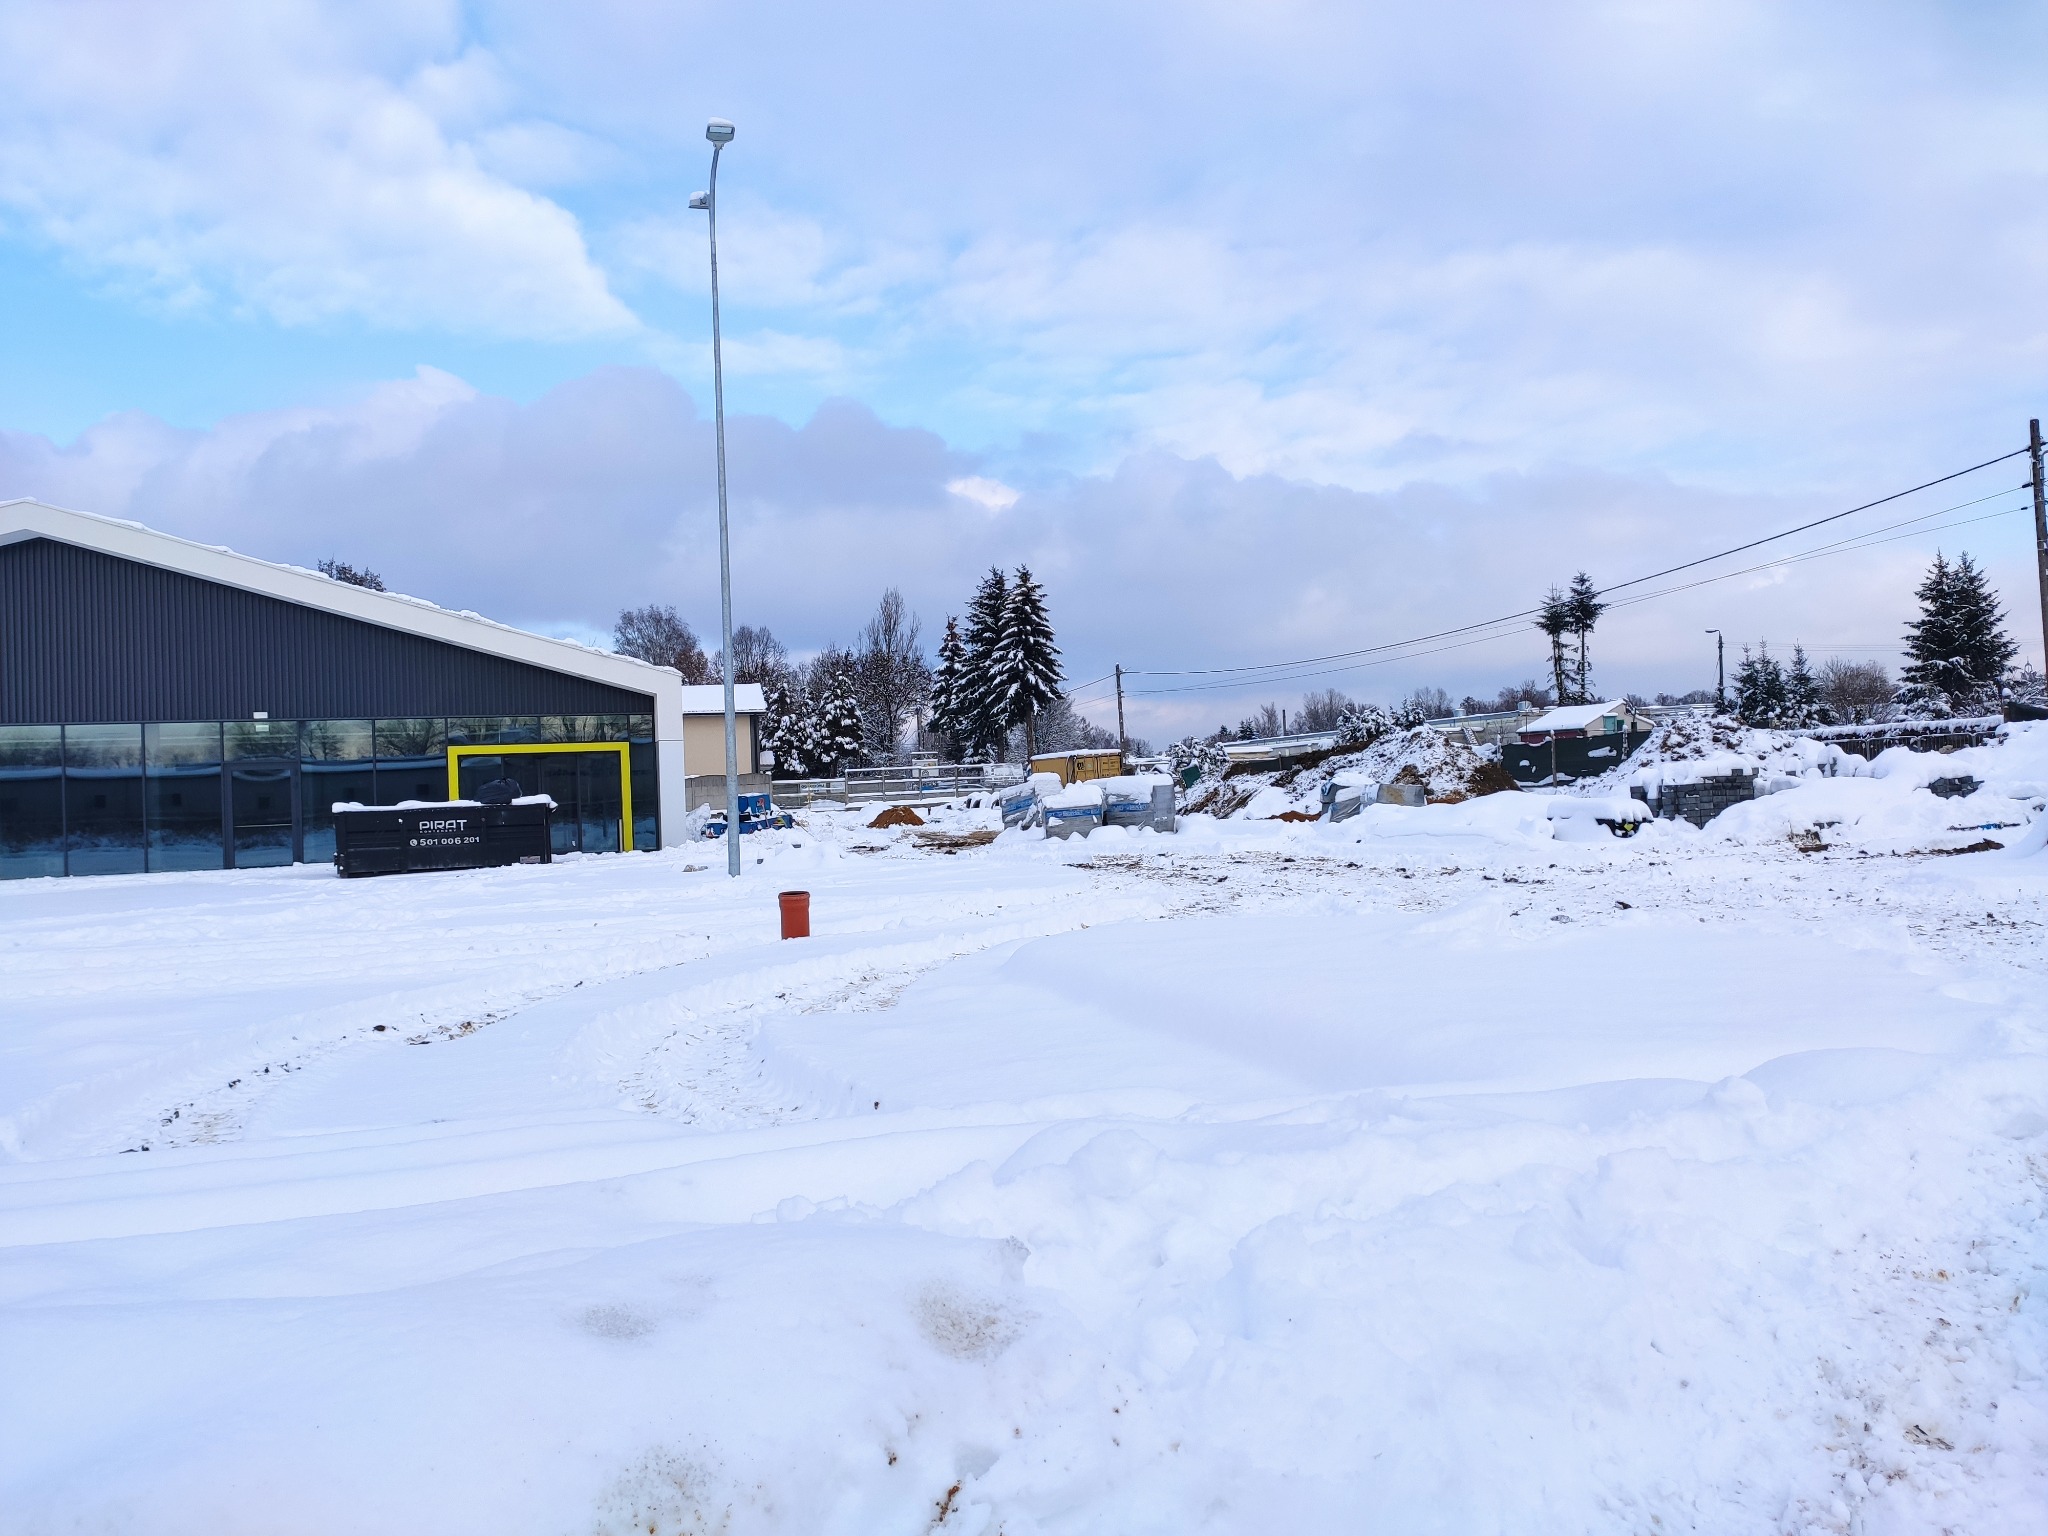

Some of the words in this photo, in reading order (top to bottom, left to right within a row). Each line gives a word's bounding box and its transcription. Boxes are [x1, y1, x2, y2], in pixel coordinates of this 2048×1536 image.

[419, 820, 467, 831] PIRAT
[420, 838, 438, 846] 501
[441, 837, 461, 845] 006
[463, 836, 480, 844] 201
